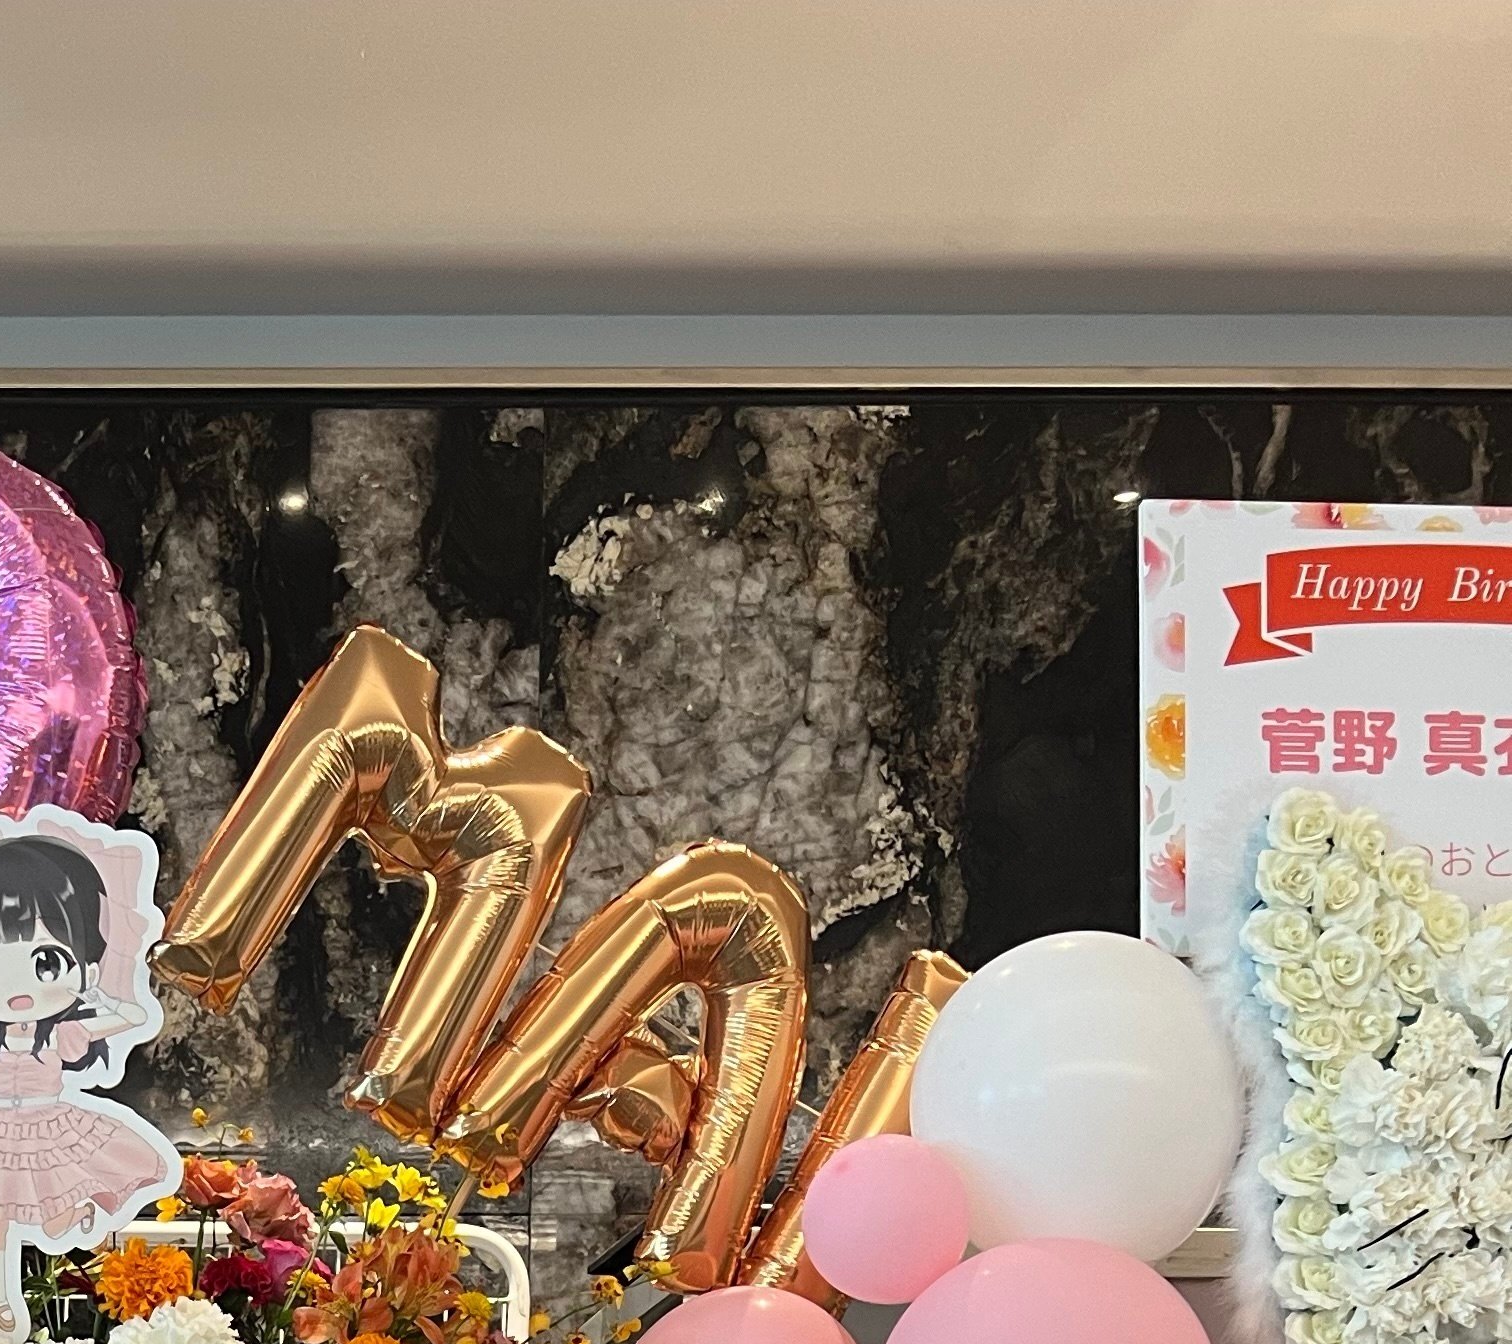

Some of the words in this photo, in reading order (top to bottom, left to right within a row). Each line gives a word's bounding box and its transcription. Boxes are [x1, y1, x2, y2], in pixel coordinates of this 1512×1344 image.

[1290, 563, 1424, 611] Happy
[1261, 707, 1398, 775] 菅野
[1423, 710, 1512, 777] 真
